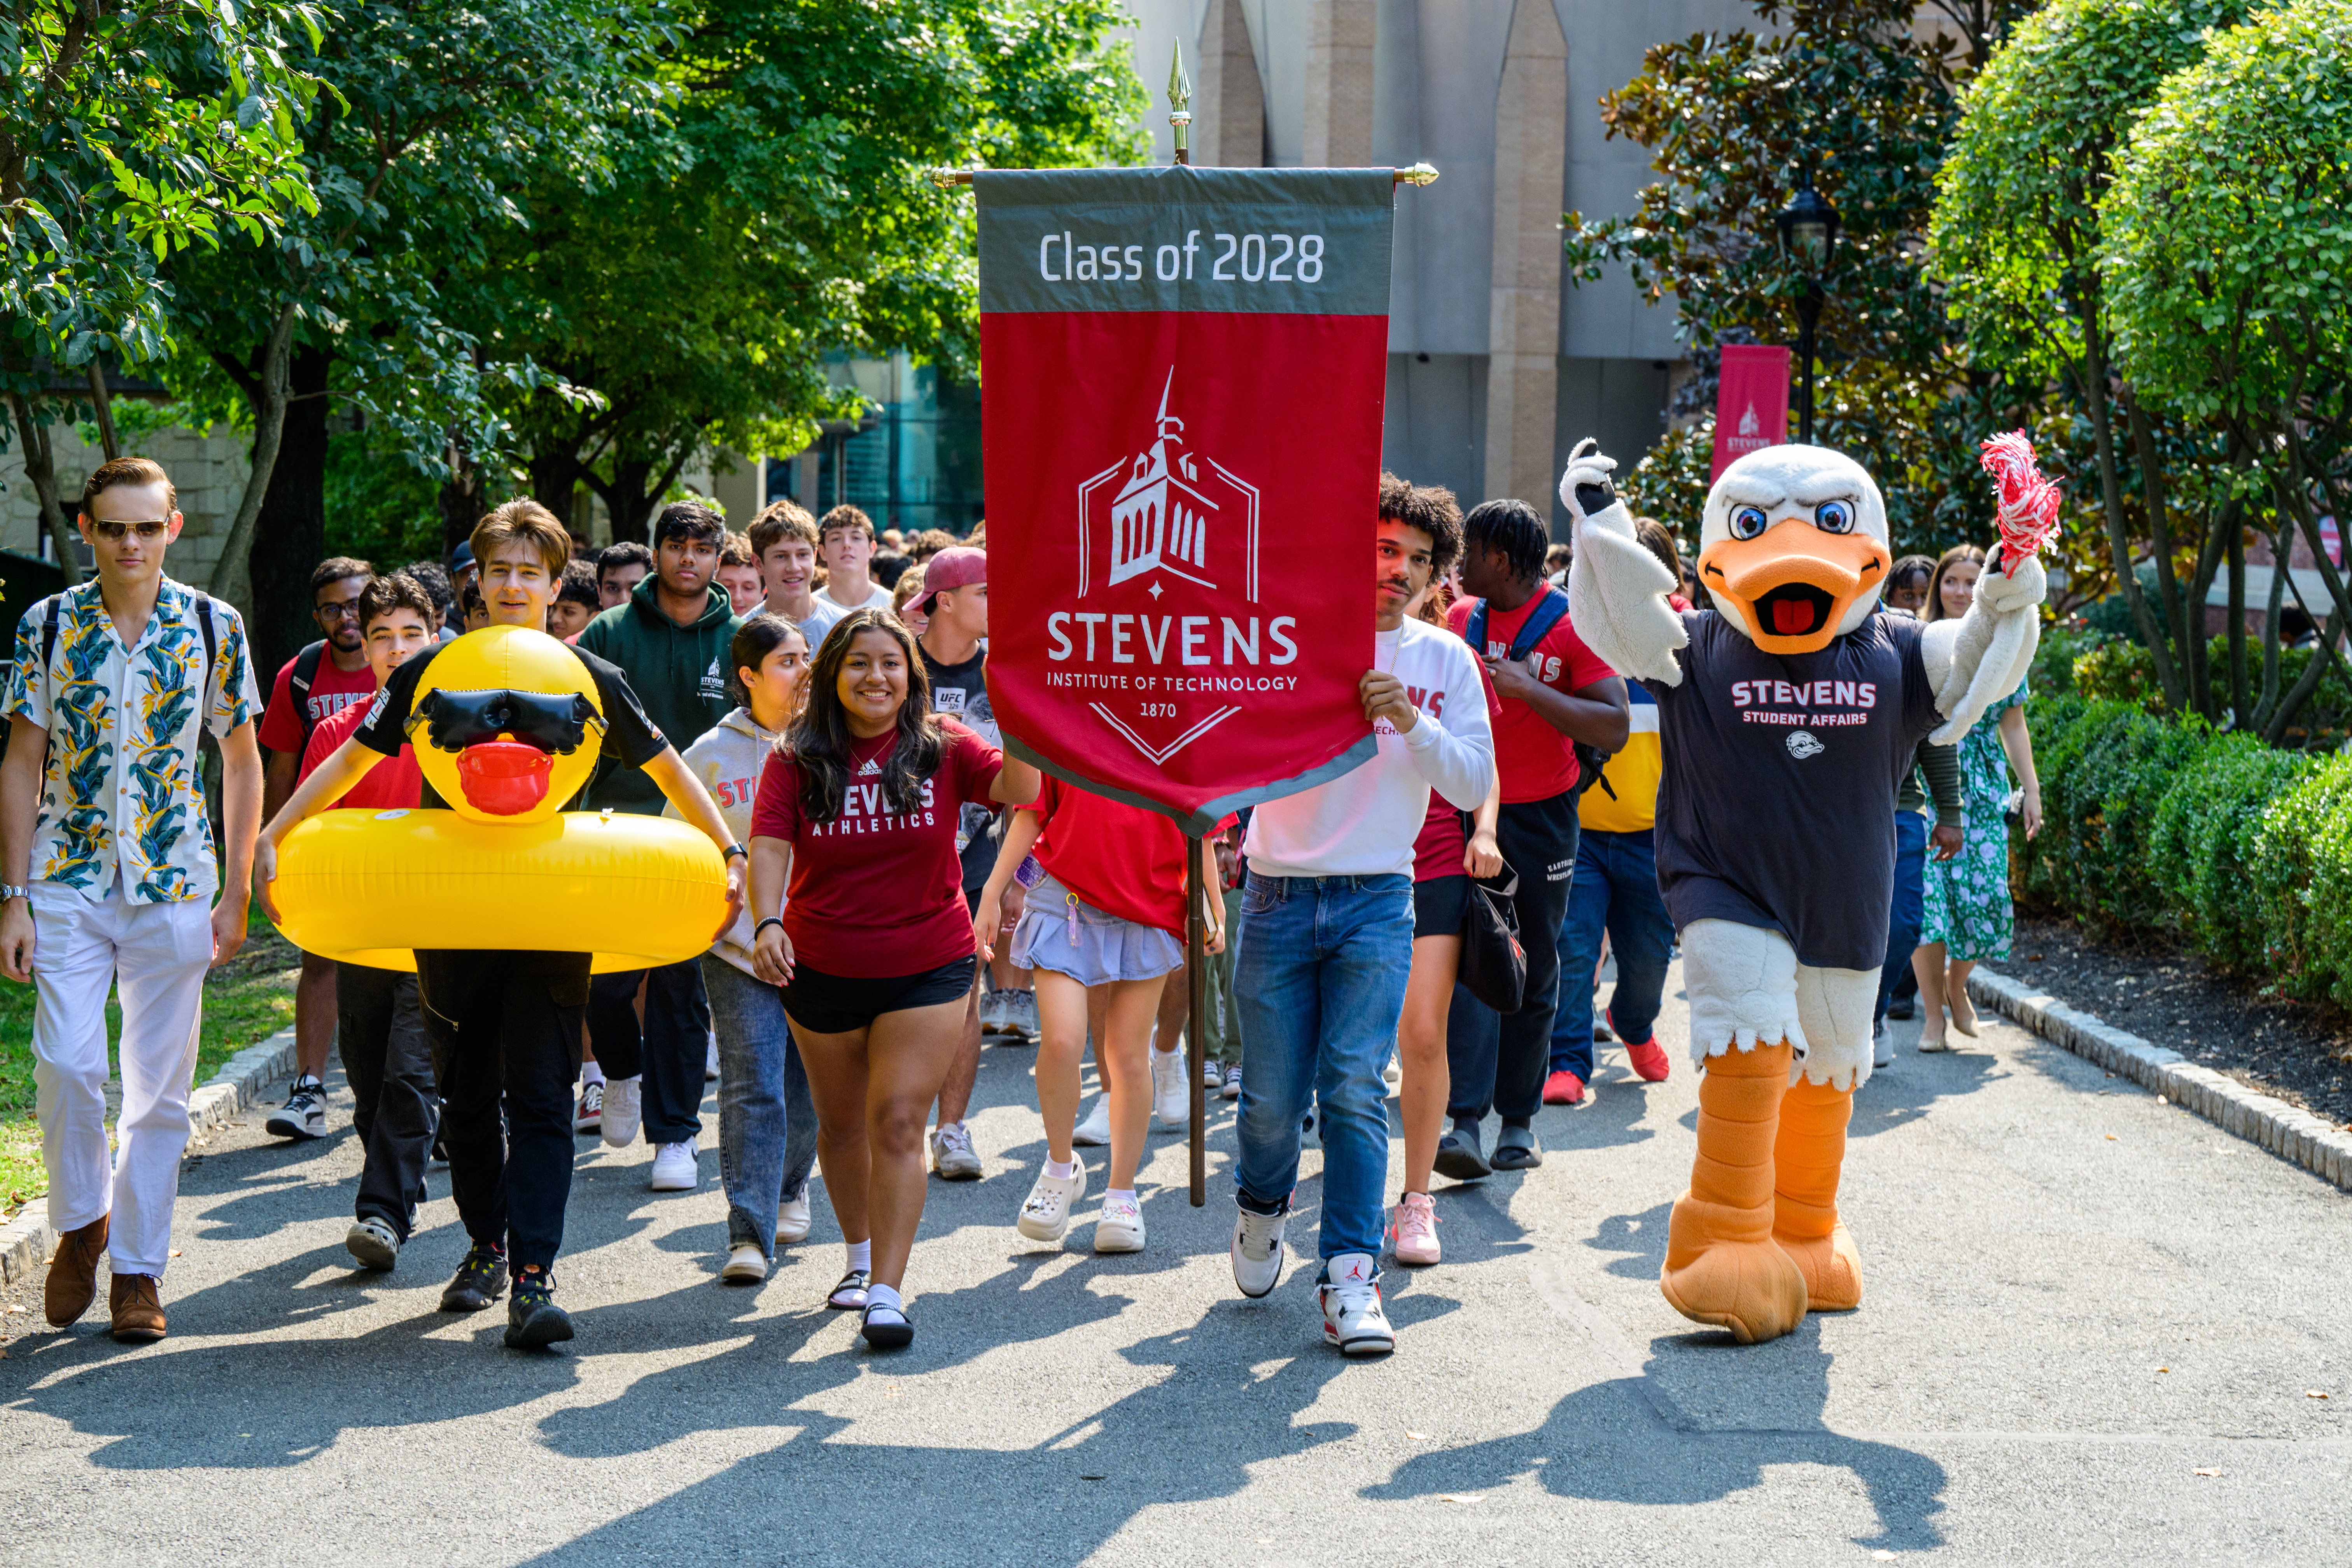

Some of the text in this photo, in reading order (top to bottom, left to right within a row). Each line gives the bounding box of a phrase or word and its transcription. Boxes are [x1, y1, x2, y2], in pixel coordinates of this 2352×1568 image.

[1040, 229, 1324, 283] Class of 2028
[1047, 611, 1298, 665] STEVENS
[701, 677, 724, 685] STEVENS
[1047, 672, 1298, 691] INSTITUTE OF TECHNOLOGY
[940, 693, 962, 703] UFC
[1731, 679, 1876, 709] STEVENS
[308, 693, 371, 719] STEV
[1141, 703, 1176, 718] 1870
[1743, 711, 1867, 726] STUDENT AFFAIRS
[1374, 726, 1402, 736] ECH
[812, 812, 934, 836] ATHLETICS
